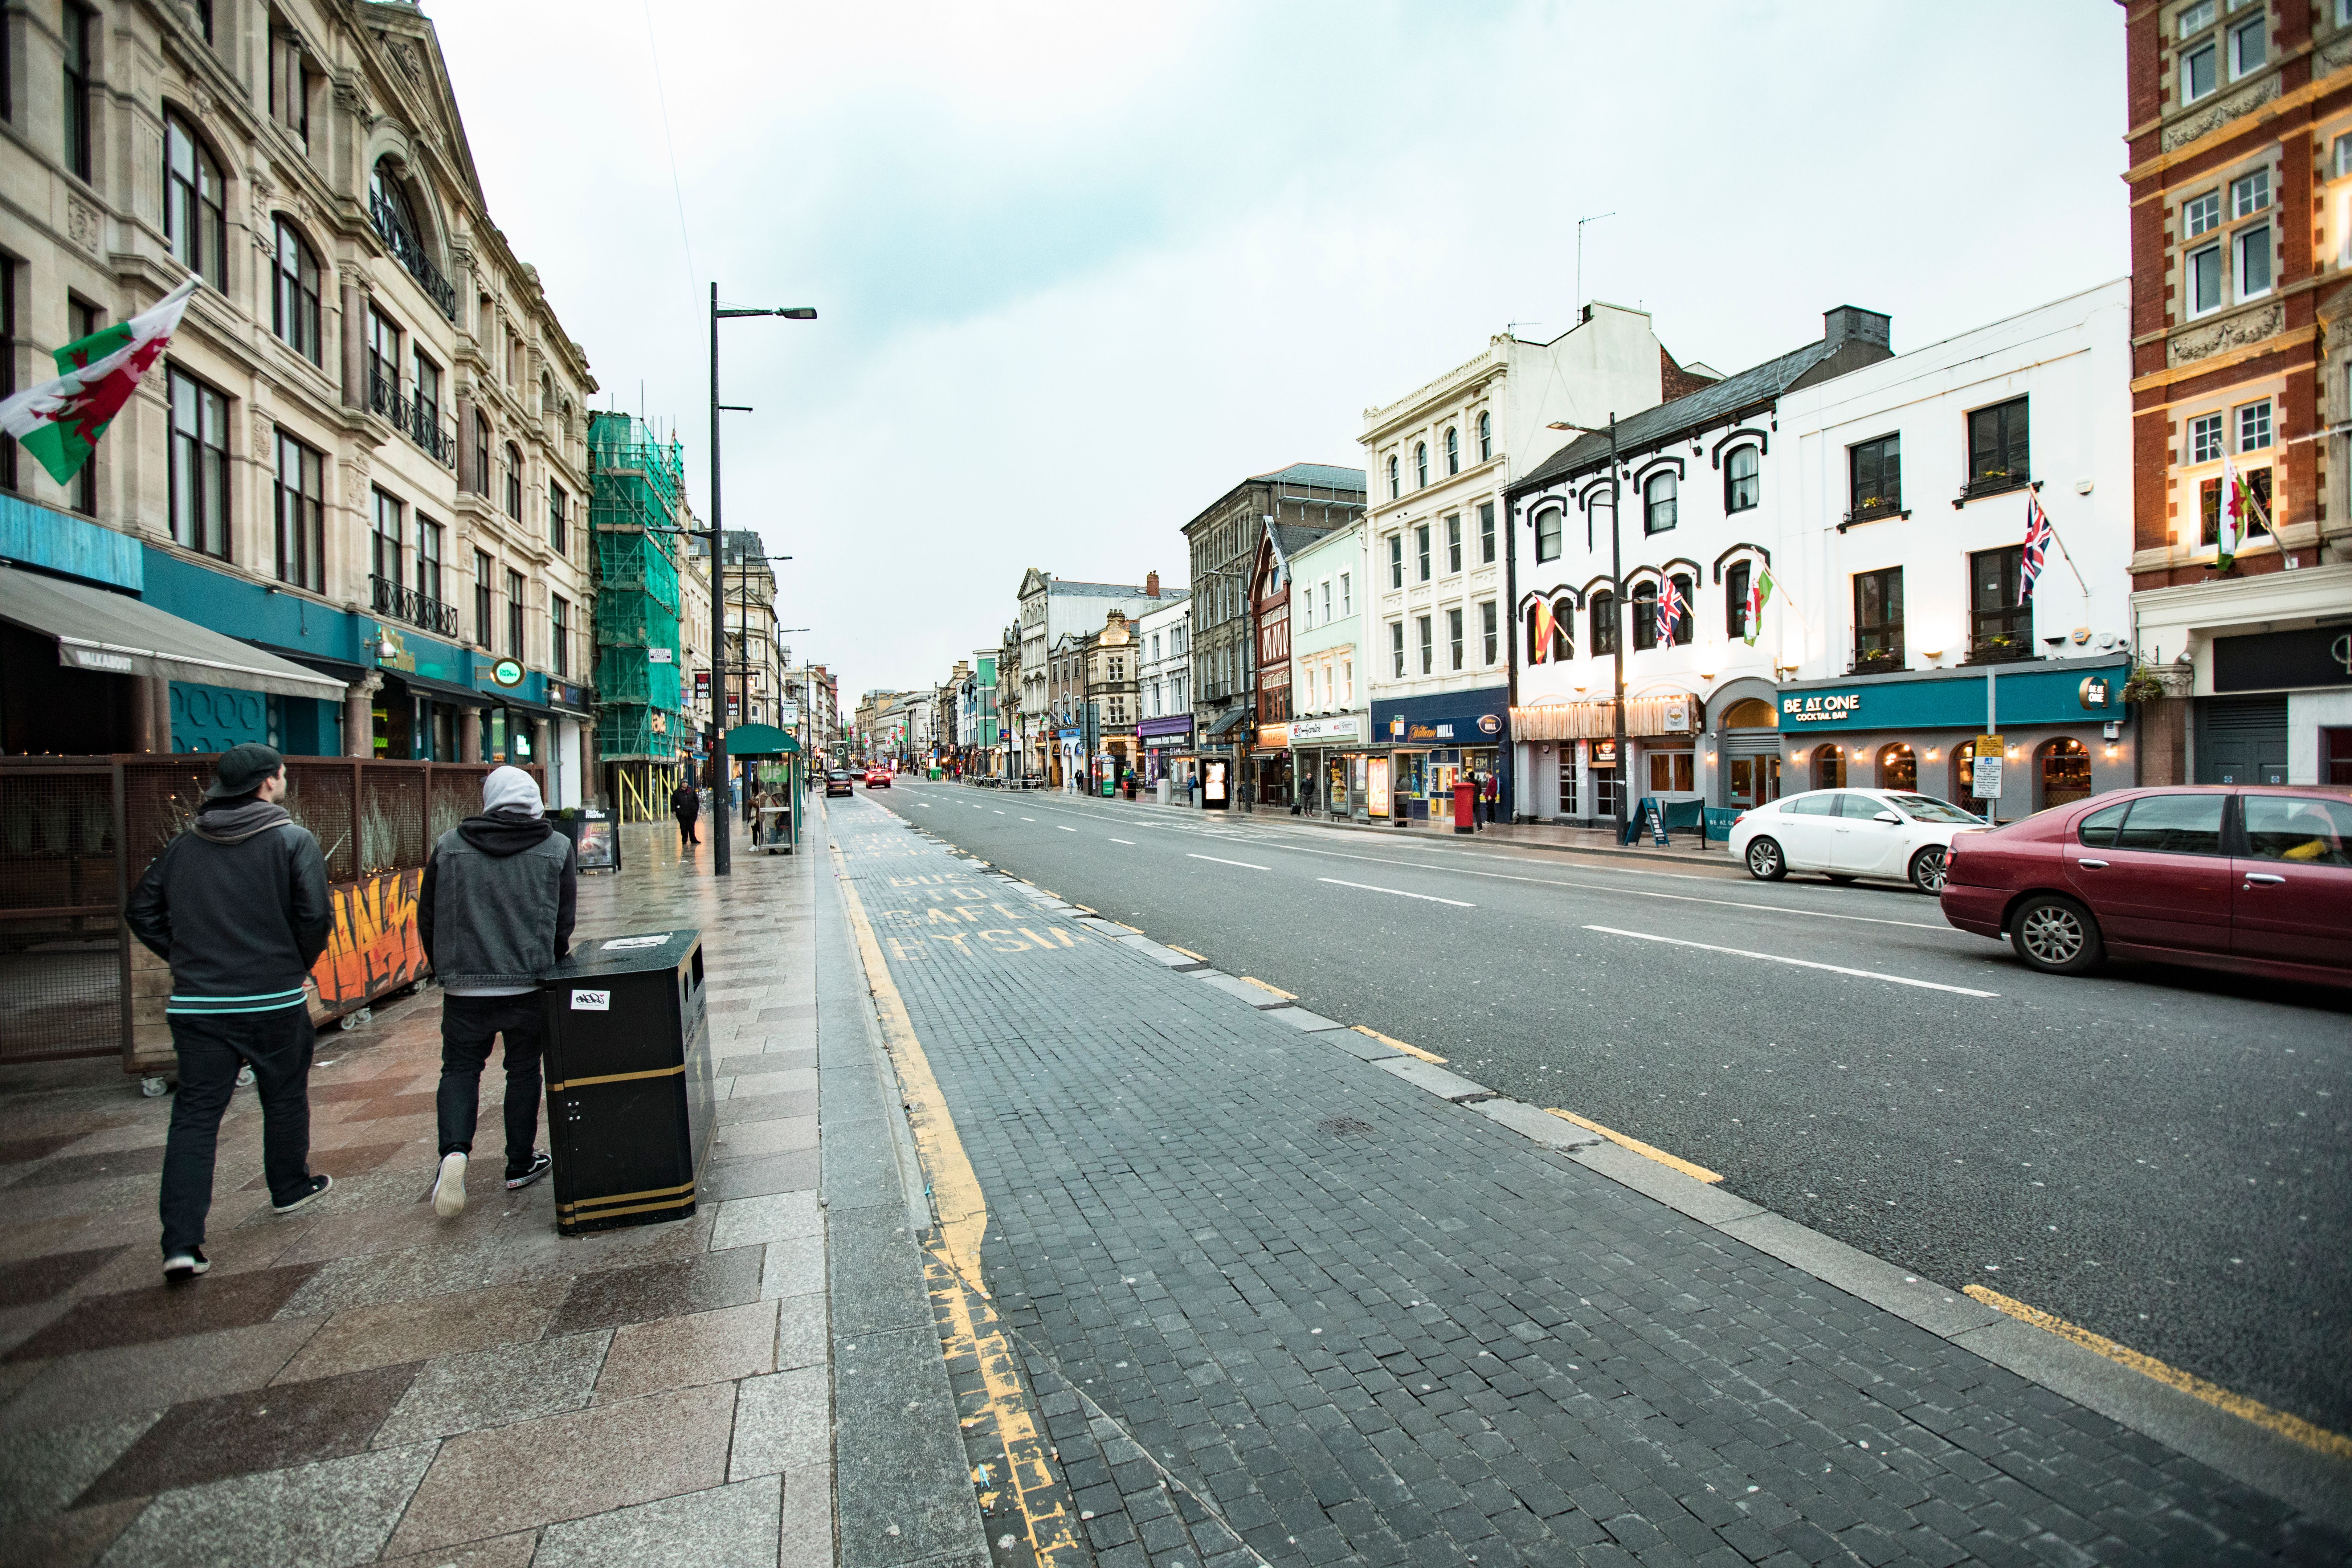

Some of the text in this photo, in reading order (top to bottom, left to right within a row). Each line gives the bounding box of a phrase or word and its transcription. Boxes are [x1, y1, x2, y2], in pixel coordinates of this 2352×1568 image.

[76, 650, 132, 671] WALKABOUT
[1784, 695, 1860, 713] BE AT ONE
[2088, 693, 2104, 702] ONE
[1796, 711, 1847, 721] COCKTAIL BAR
[1306, 723, 1321, 737] Gamlin's
[1410, 724, 1454, 739] William HILL
[1475, 758, 1487, 767] £1M
[766, 768, 782, 779] JP
[889, 873, 976, 887] BUS
